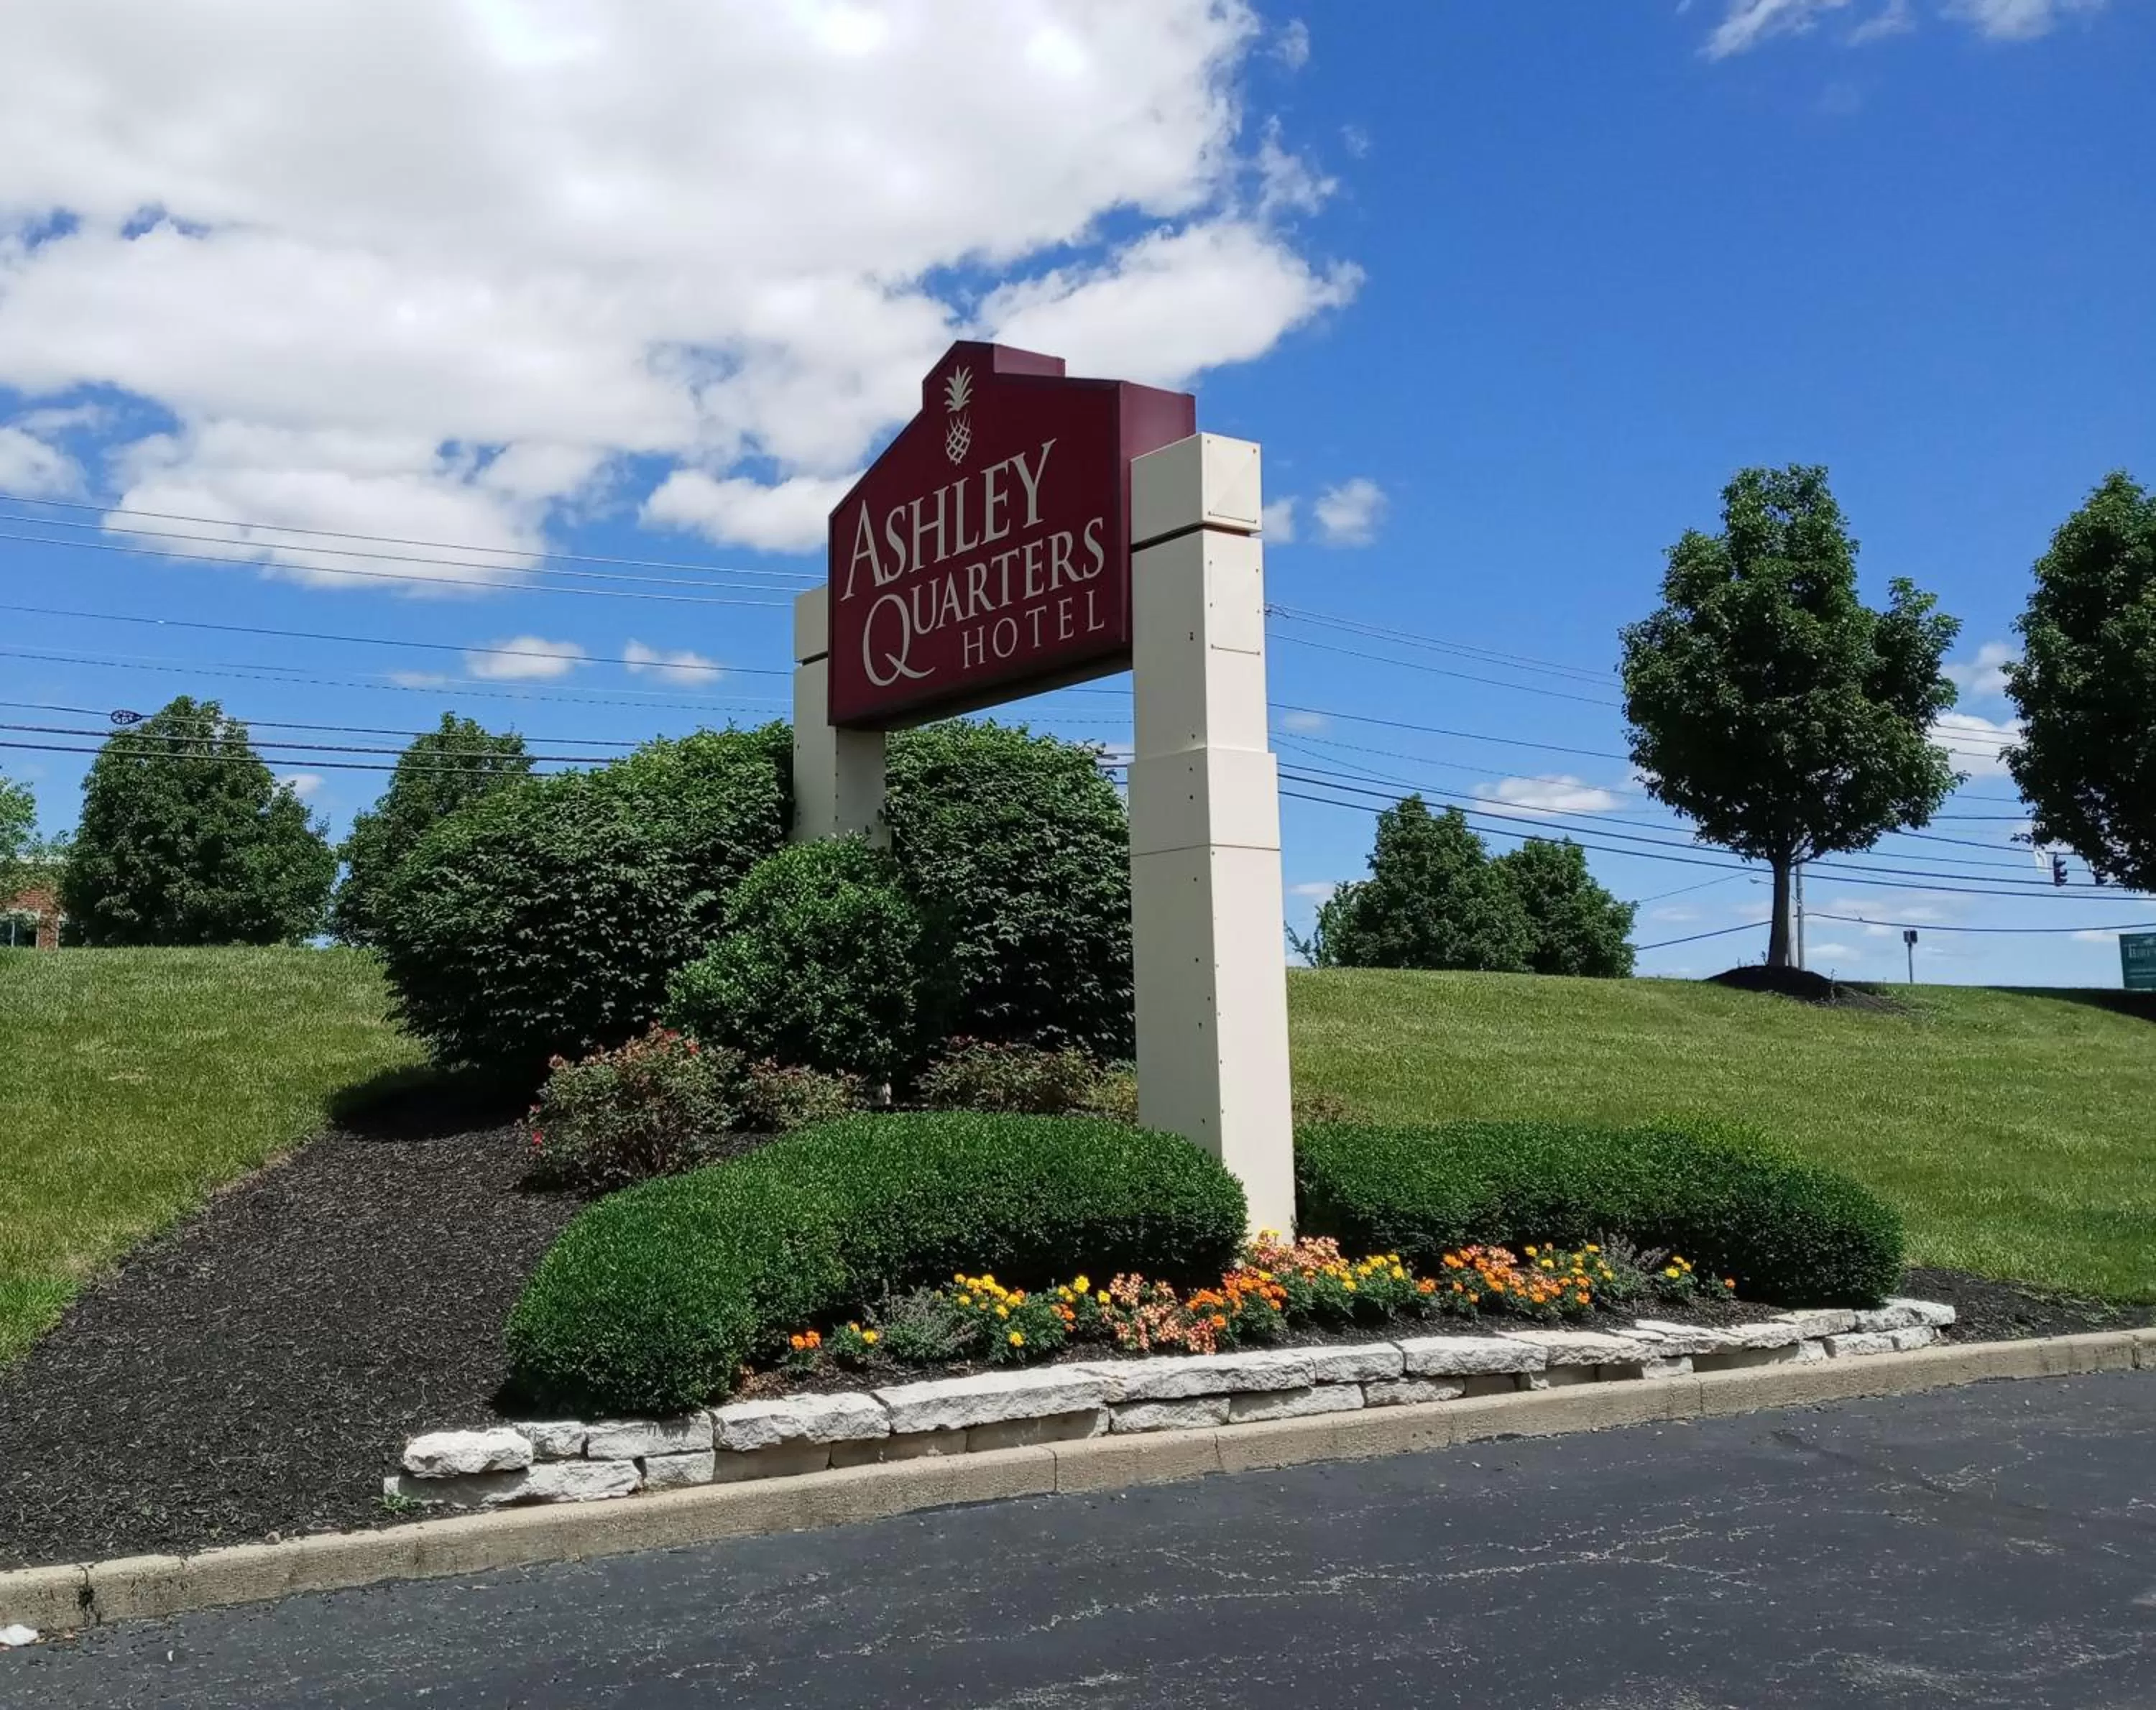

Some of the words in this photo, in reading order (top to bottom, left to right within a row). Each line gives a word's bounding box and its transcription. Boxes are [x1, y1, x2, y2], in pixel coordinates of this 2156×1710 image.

[840, 438, 1057, 601] ASHLEY
[862, 517, 1105, 687] QUARTERS
[962, 589, 1105, 670] HOTEL
